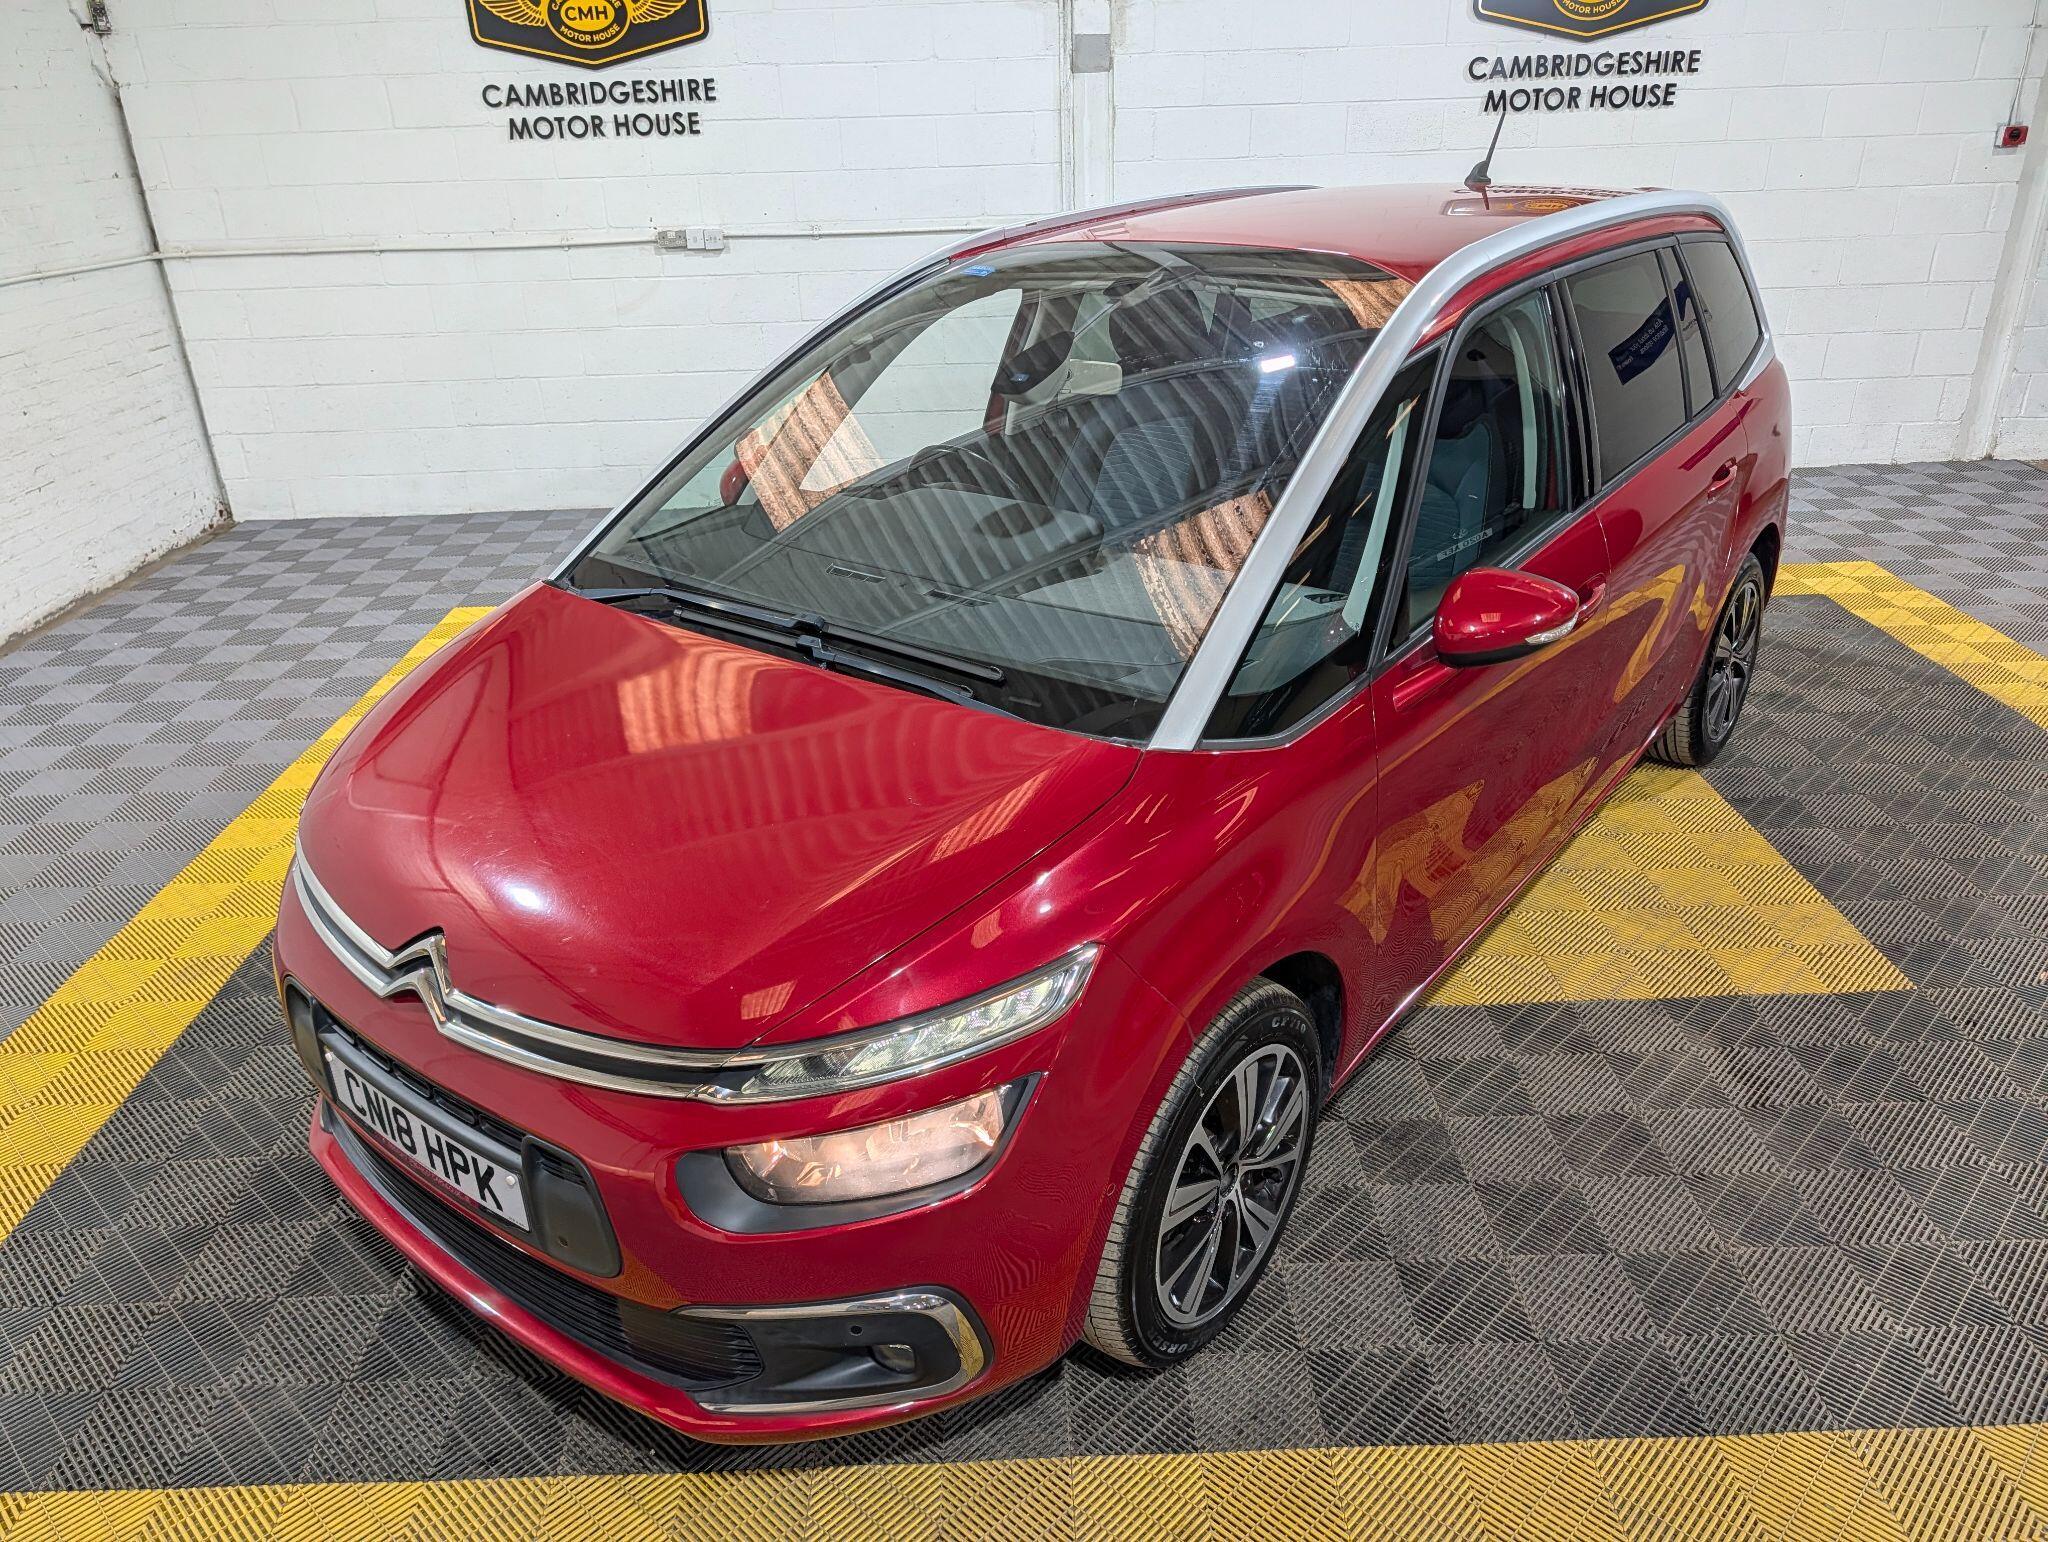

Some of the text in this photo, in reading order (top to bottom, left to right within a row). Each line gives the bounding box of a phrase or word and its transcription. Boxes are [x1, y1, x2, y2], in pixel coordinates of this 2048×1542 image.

[564, 6, 609, 21] CMH
[1562, 0, 1591, 14] MOTOR
[560, 23, 620, 42] MOTOR HOUSE
[1468, 49, 1702, 81] CAMBRIDGESHIRE
[482, 78, 717, 109] CAMBRIDGESHIRE
[1484, 82, 1677, 112] MOTOR HOUSE
[509, 111, 701, 140] MOTOR HOUSE
[344, 1068, 504, 1212] CN18 HPK
